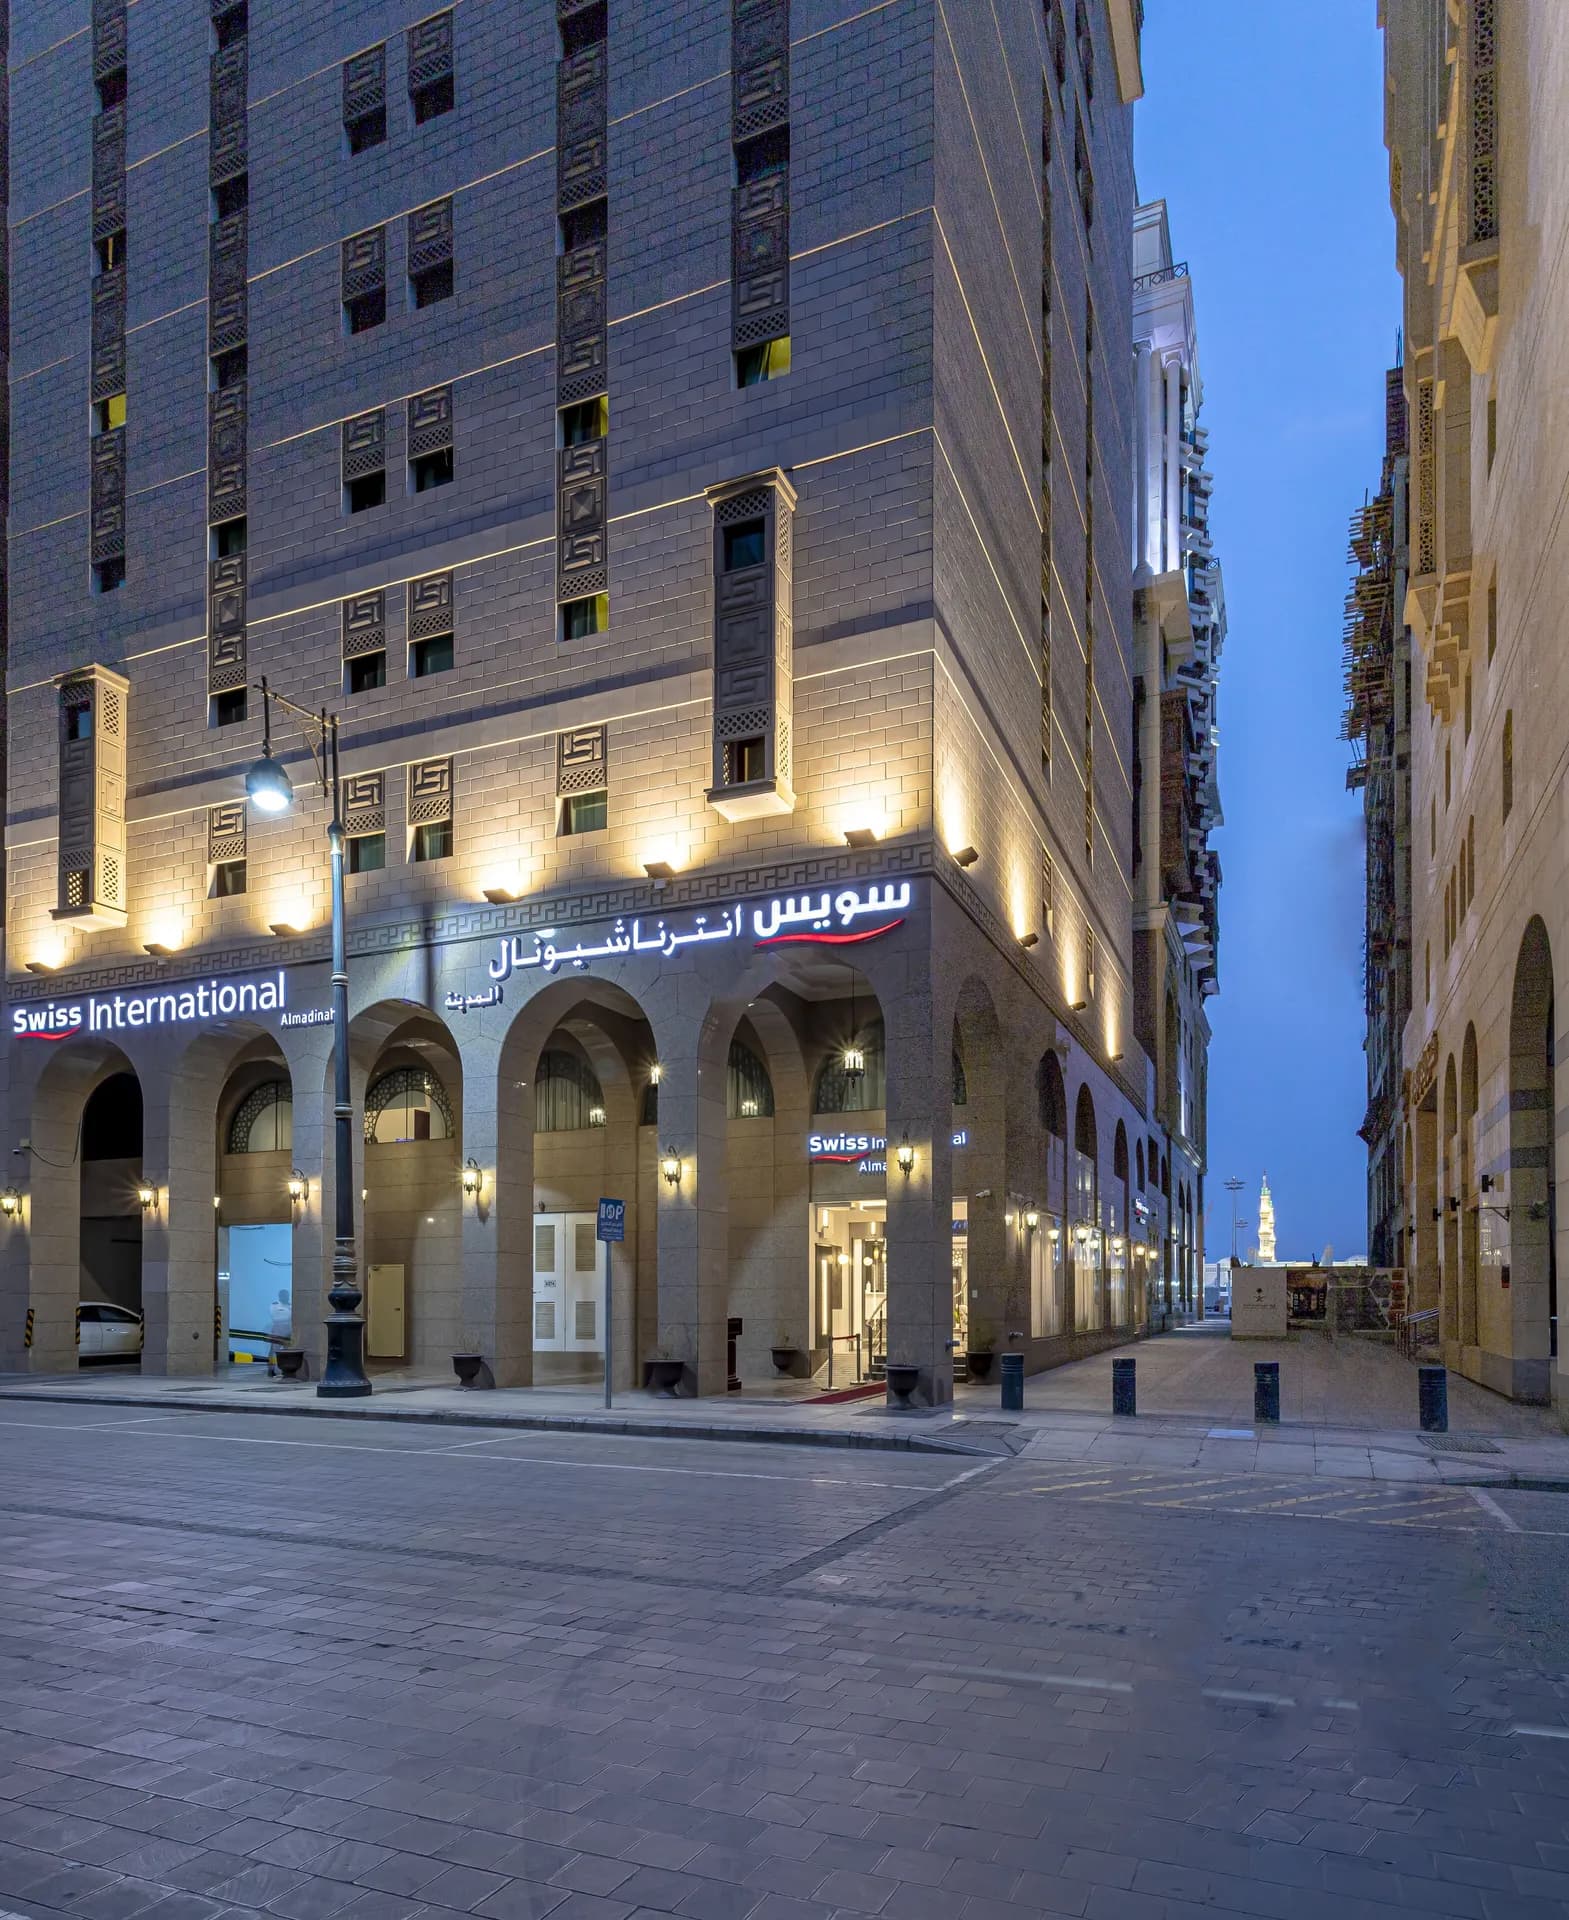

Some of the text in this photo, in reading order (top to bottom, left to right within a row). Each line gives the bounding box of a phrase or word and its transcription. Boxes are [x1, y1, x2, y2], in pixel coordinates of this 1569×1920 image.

[489, 882, 911, 978] سويس انترناشيونال
[13, 971, 285, 1033] Swiss International
[444, 985, 499, 1010] المدينة
[809, 1132, 869, 1152] Swiss
